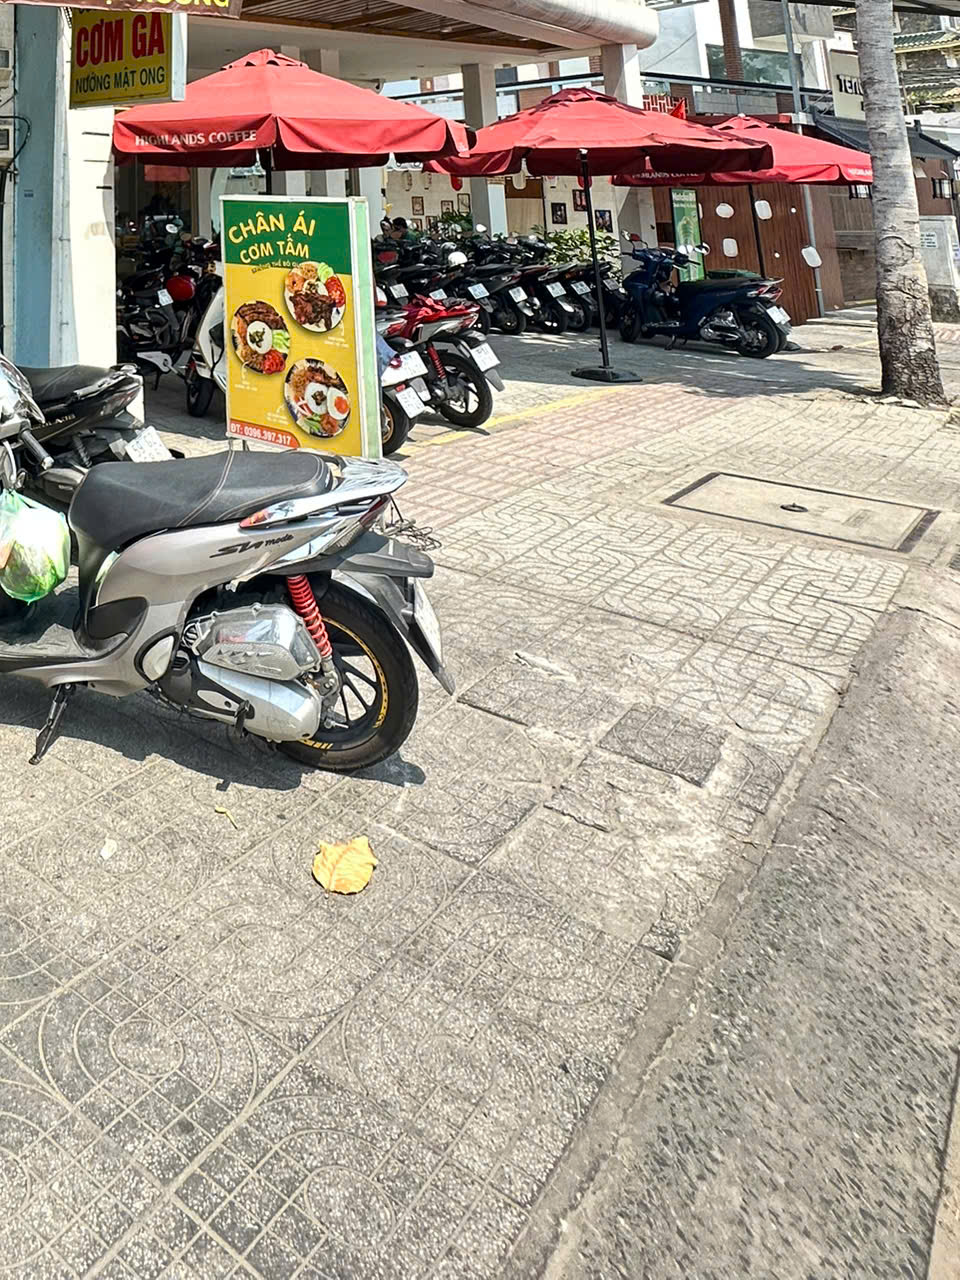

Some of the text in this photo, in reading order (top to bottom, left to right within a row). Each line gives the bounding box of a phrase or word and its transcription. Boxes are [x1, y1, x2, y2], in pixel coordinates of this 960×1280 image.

[75, 18, 125, 68] CƠM
[75, 65, 165, 93] NƯỚNG MẬT ONG
[135, 129, 257, 147] HIGHLANDS COFFEE
[228, 210, 316, 244] CHÂN ÁI
[240, 233, 309, 263] CƠM TẤM
